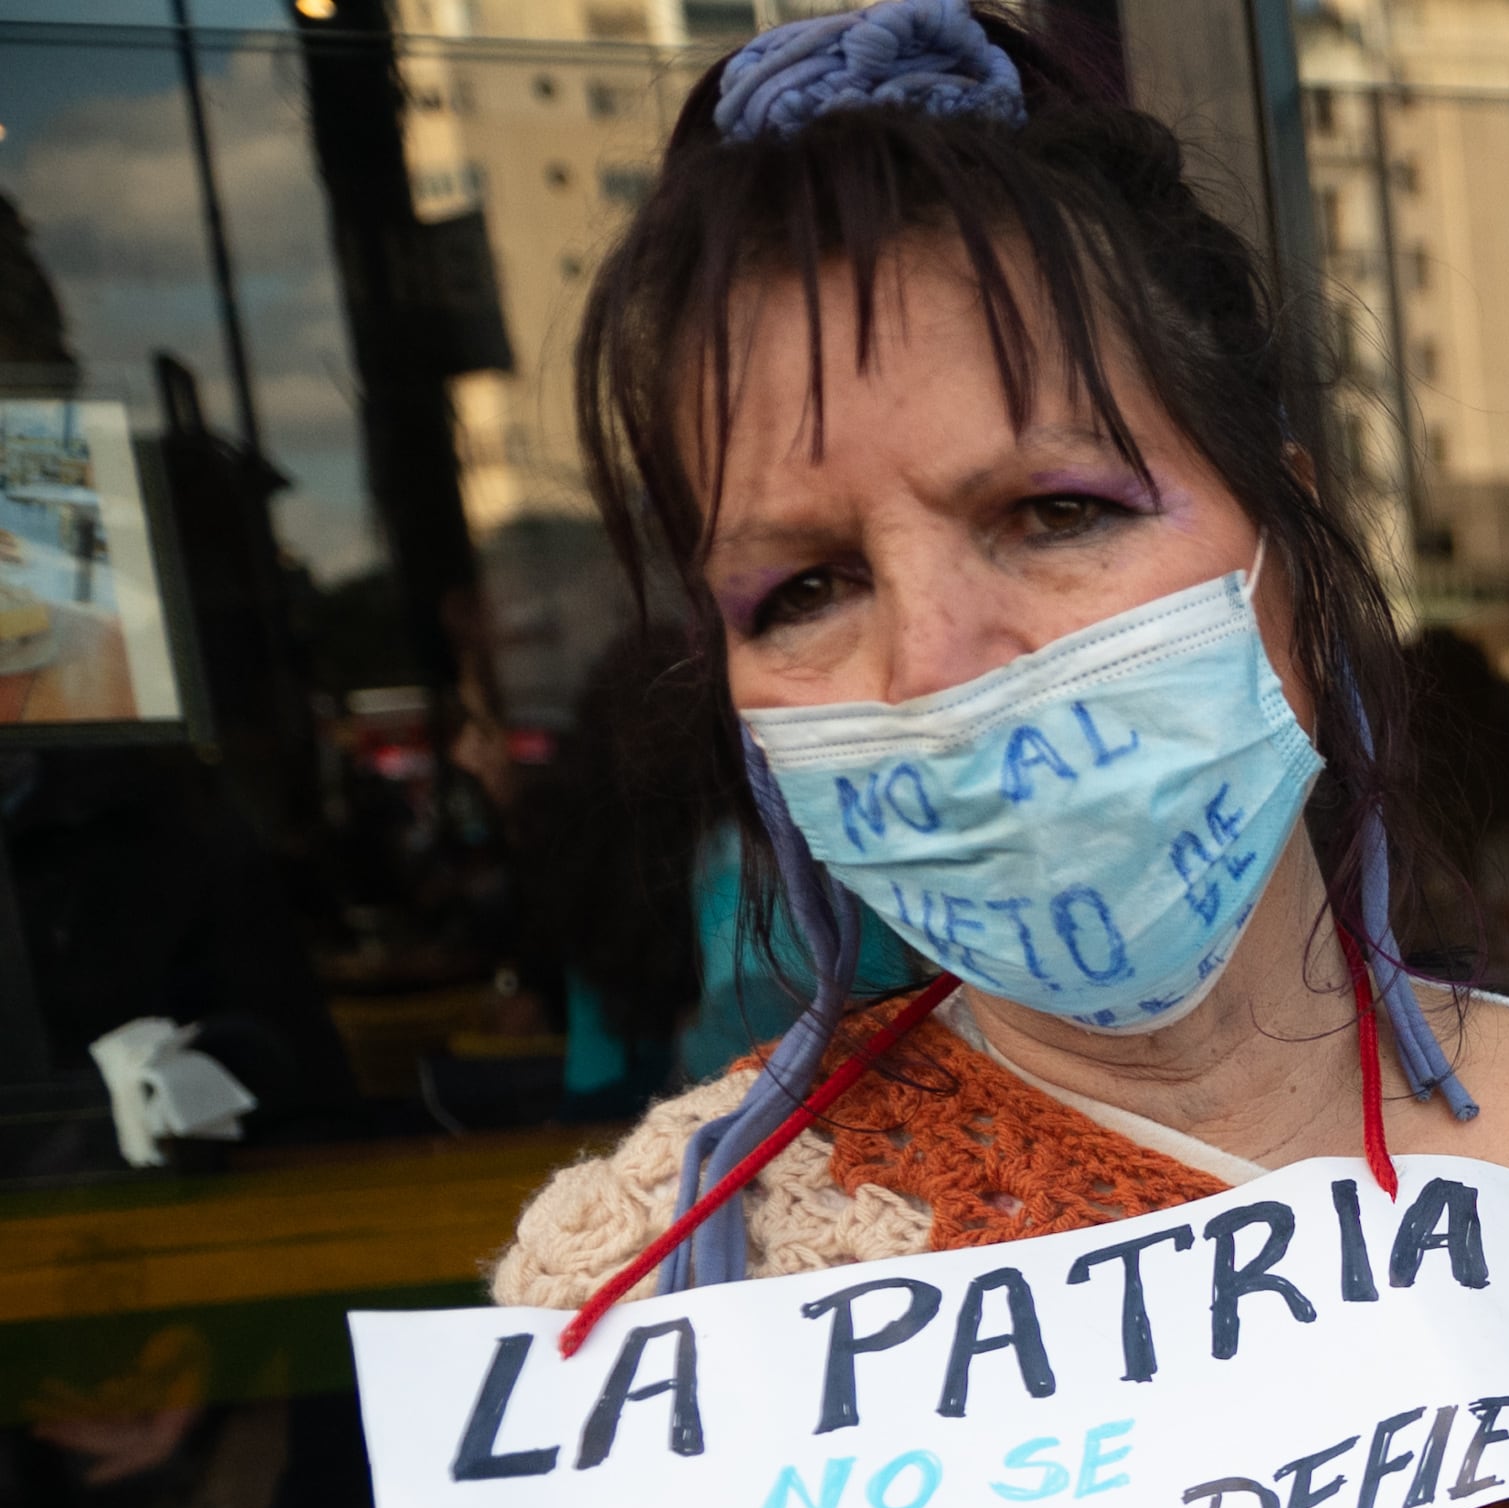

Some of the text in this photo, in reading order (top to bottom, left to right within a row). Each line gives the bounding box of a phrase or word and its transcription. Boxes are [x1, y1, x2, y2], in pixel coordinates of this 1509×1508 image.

[834, 700, 1139, 853] NO AL
[889, 879, 1135, 992] VETO
[450, 1176, 1490, 1482] LA PATRIA
[988, 1417, 1137, 1505] SE
